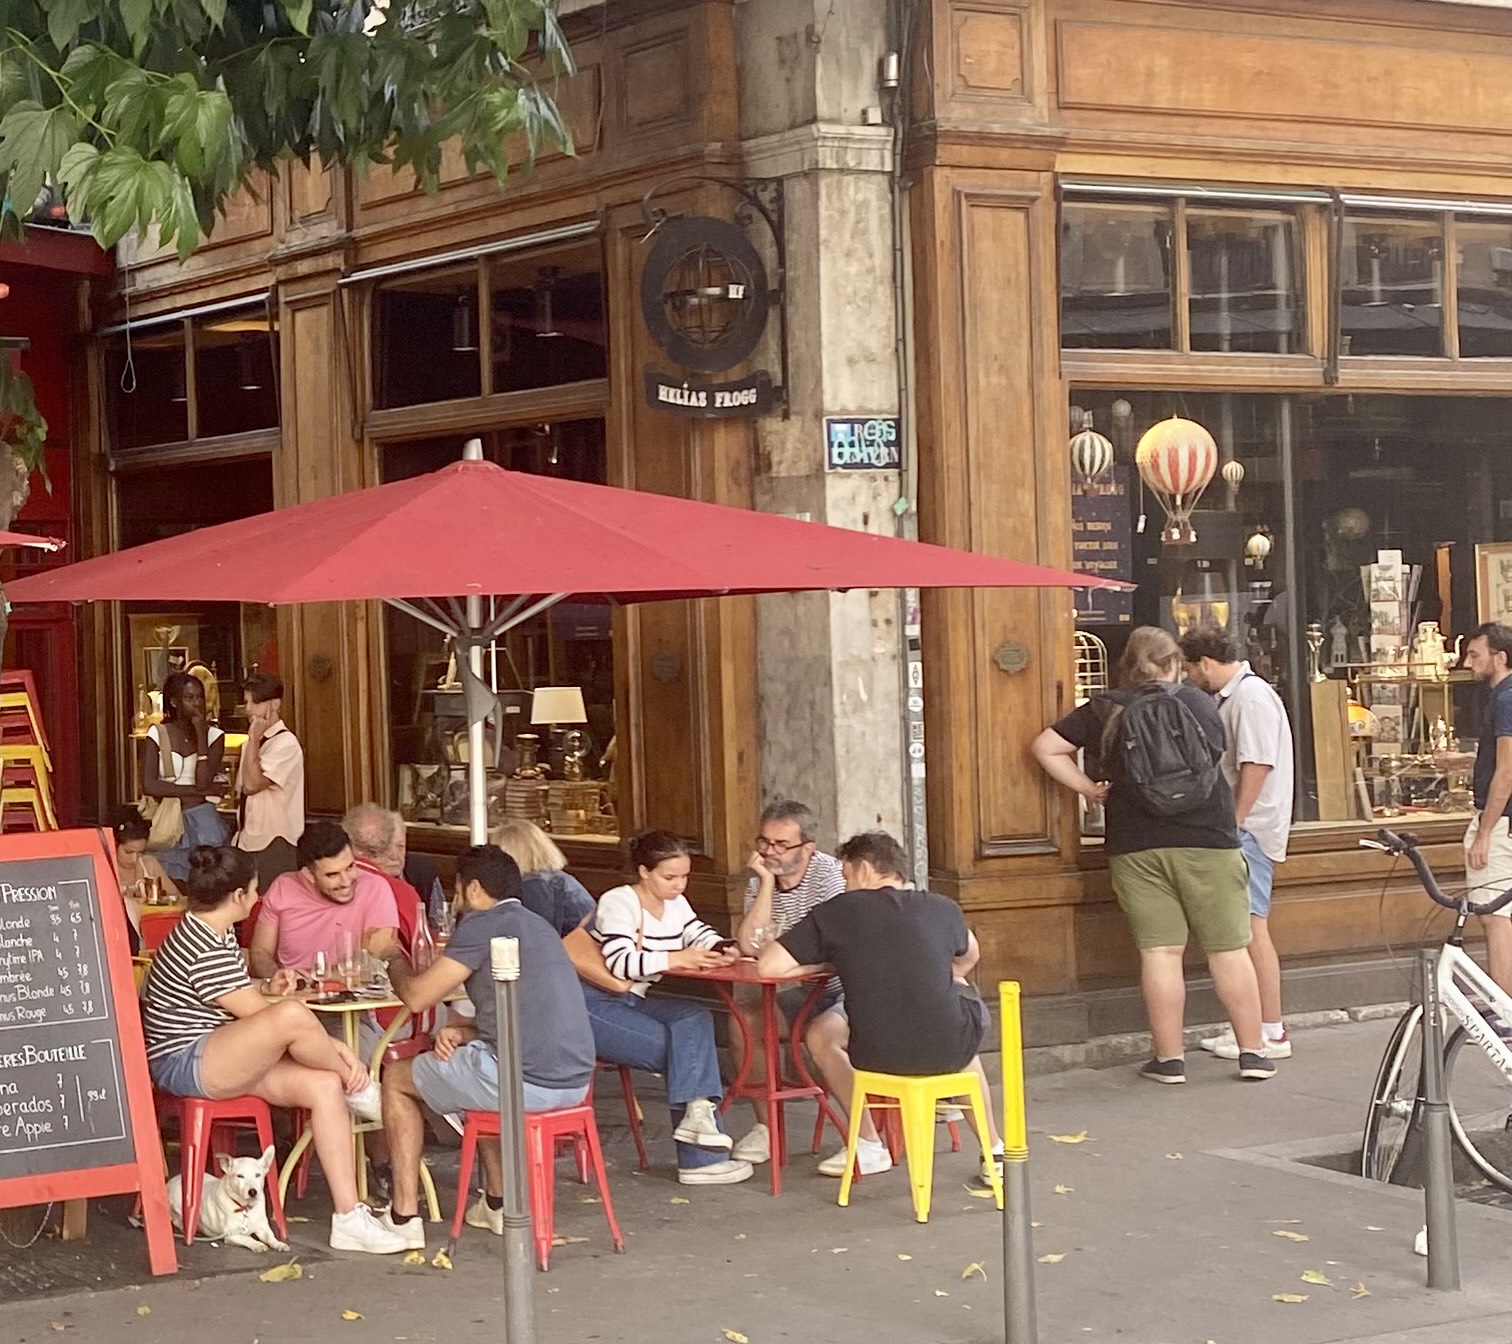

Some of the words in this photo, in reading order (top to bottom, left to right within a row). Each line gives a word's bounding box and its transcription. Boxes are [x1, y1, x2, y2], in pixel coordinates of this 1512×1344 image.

[728, 284, 745, 298] HF
[714, 389, 757, 407] FROGG
[0, 882, 57, 904] PRESSION
[28, 949, 44, 962] IPA
[14, 984, 55, 1000] Blonde
[15, 1005, 46, 1023] Rouge
[22, 1044, 87, 1065] BOUTEILLE
